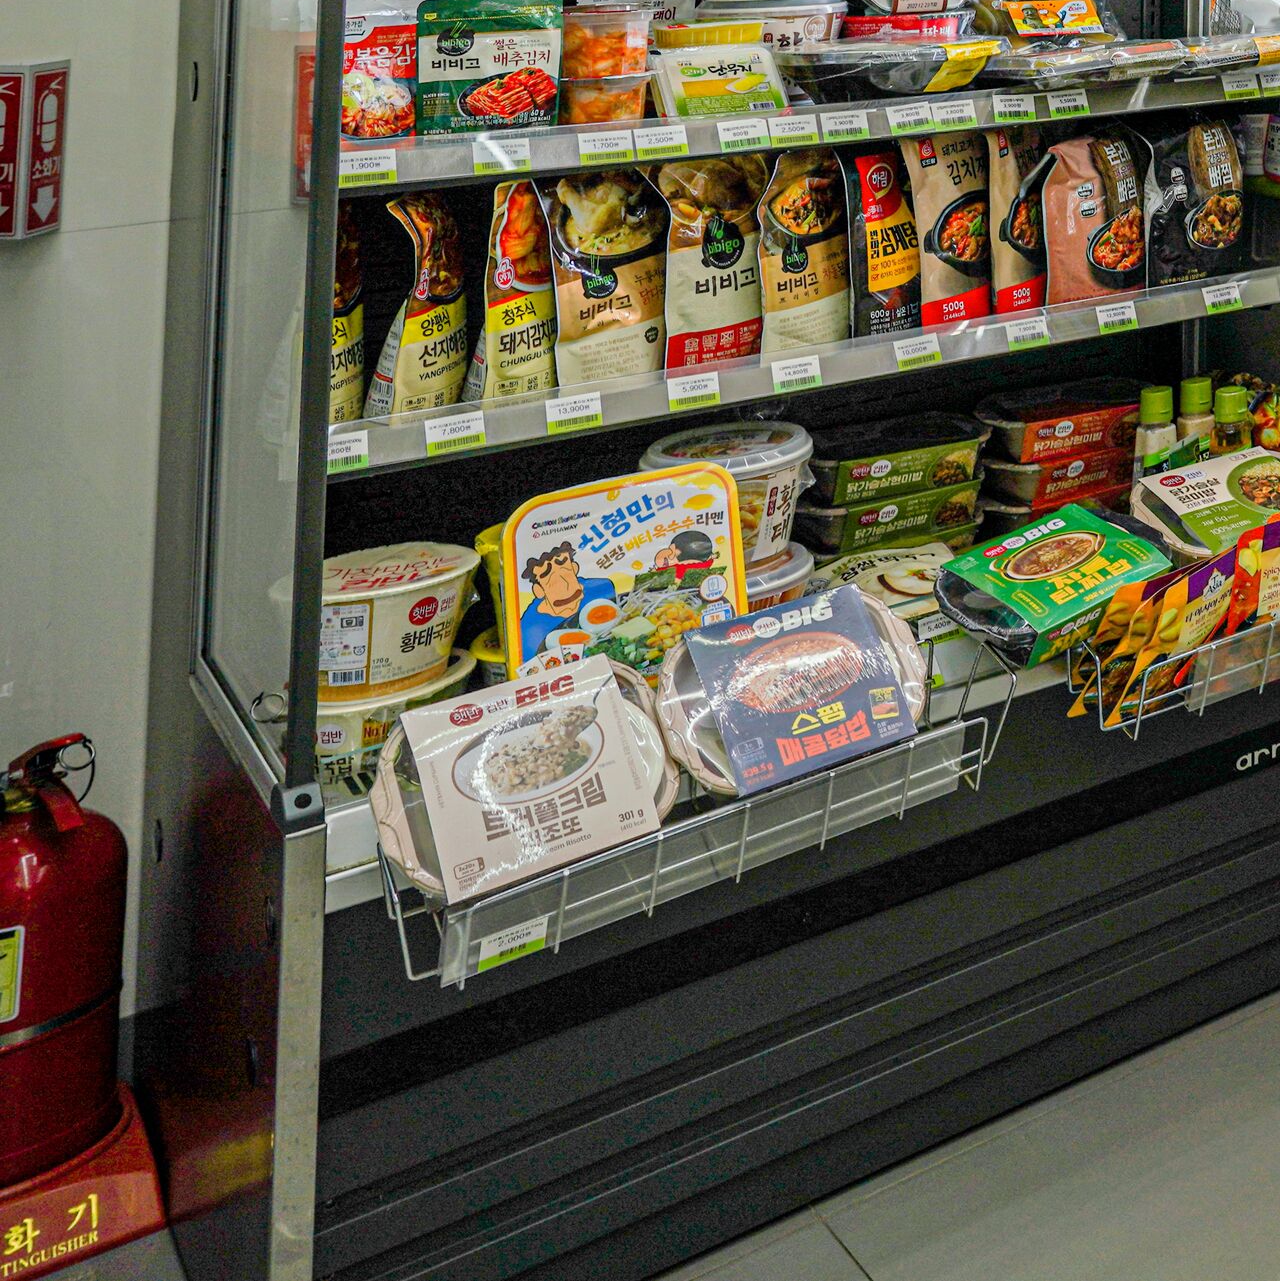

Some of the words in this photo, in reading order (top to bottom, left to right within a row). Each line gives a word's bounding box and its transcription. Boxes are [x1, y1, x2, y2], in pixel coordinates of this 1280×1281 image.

[492, 37, 517, 52] 썰은
[431, 57, 482, 71] 비비고
[492, 49, 552, 65] 배추김치
[707, 63, 753, 78] 단무지
[592, 140, 621, 150] 1,700원
[32, 155, 61, 180] 소화기
[1207, 162, 1233, 189] 뼈찜
[871, 168, 894, 186] 하림
[707, 237, 740, 258] bibigo
[694, 269, 757, 298] 비비고
[500, 304, 537, 324] 청주식
[942, 300, 965, 314] 500g
[419, 307, 451, 336] 양평식
[499, 350, 542, 369] CHUNGJU
[558, 404, 591, 415] 13,900원
[539, 524, 578, 537] ALPHAWAY
[578, 492, 677, 554] 신형만의
[594, 543, 627, 570] 된장
[624, 530, 653, 556] 버터
[652, 517, 696, 544] 옥수수
[696, 511, 725, 528] 라멘
[1263, 562, 1280, 577] Spicy
[452, 707, 483, 722] 햇반
[515, 676, 575, 708] BIG
[790, 701, 846, 735] 스팸
[617, 812, 637, 824] 301
